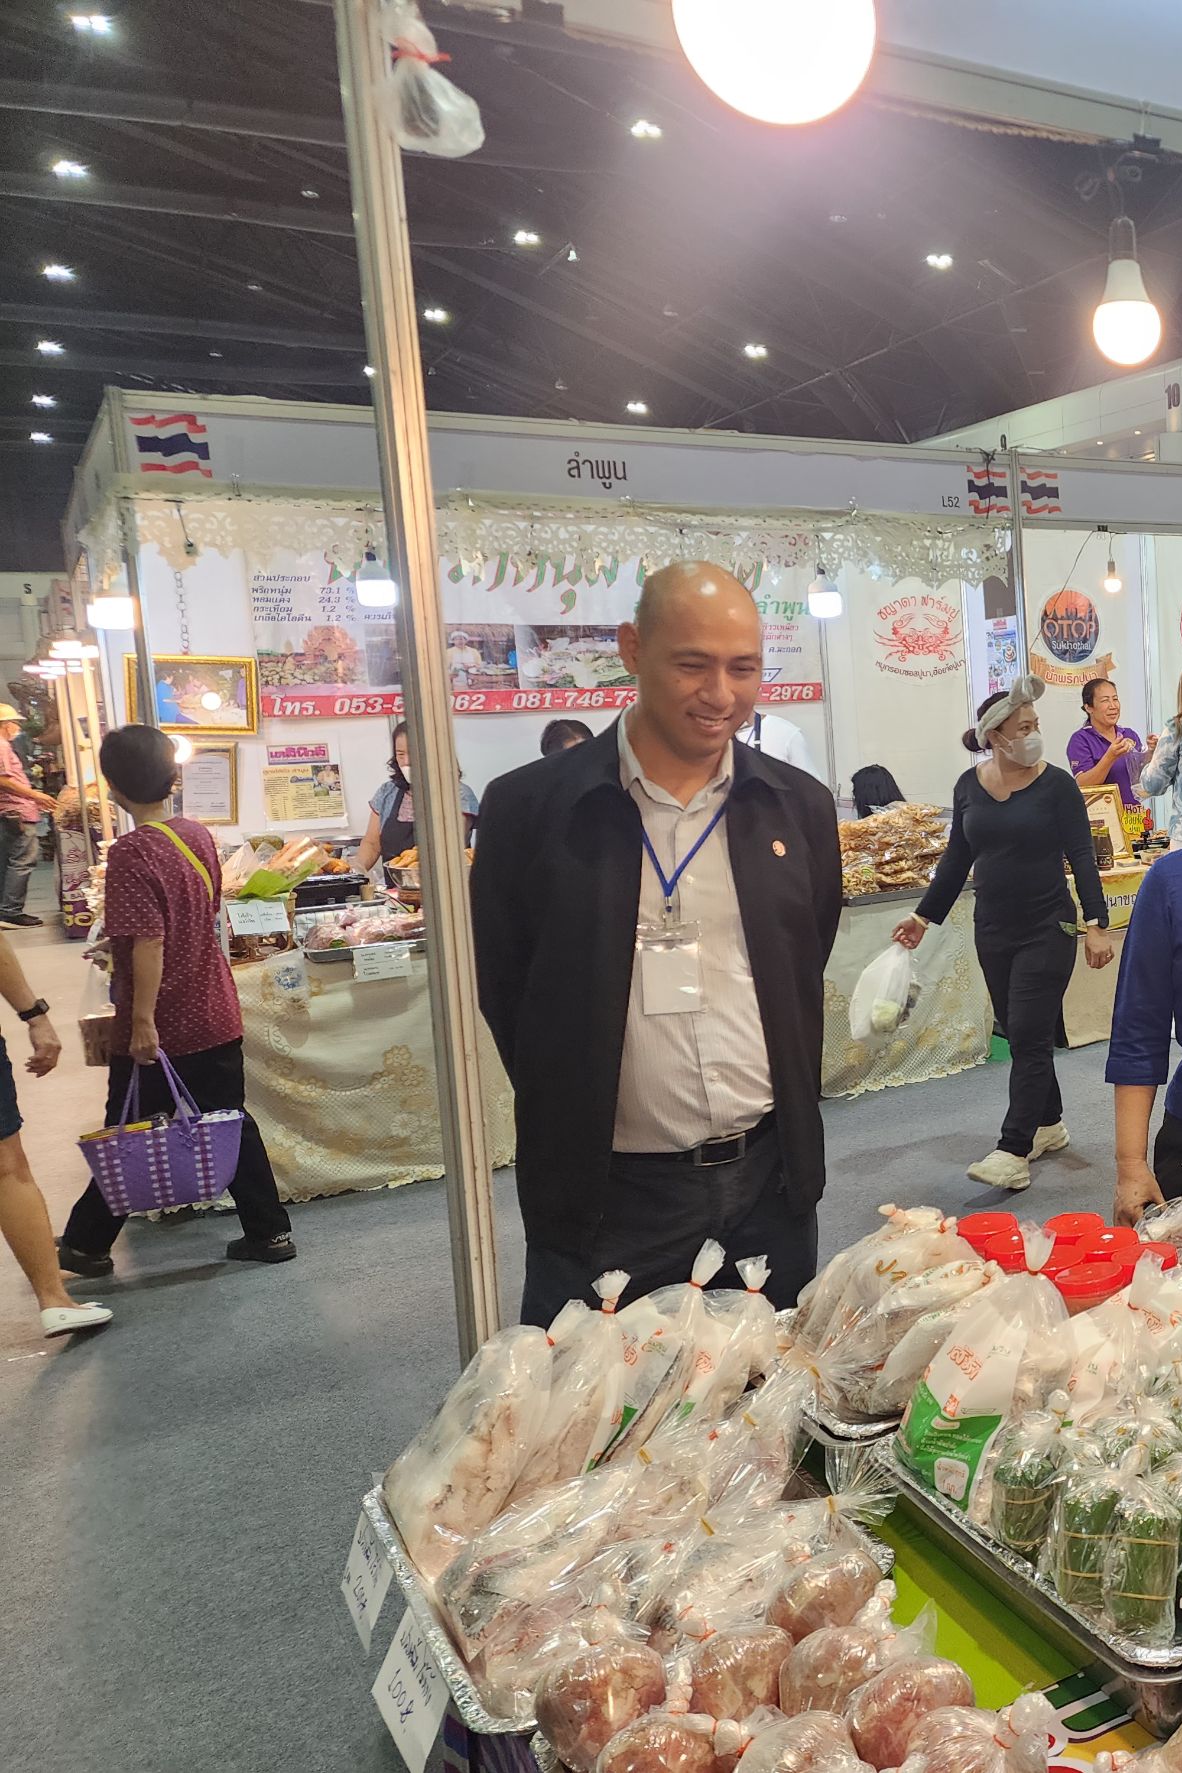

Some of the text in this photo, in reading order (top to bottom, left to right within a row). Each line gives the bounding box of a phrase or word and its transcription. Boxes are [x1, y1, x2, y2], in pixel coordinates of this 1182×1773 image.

[1165, 383, 1181, 410] 10
[567, 451, 628, 490] ลำพูน
[942, 496, 960, 508] L52
[318, 596, 341, 604] 24.3
[326, 614, 341, 622] 1.2
[1043, 619, 1096, 639] OTOP
[1051, 640, 1092, 651] Sukhothai
[273, 692, 320, 716] โทร.
[512, 690, 640, 709] 081-746-73
